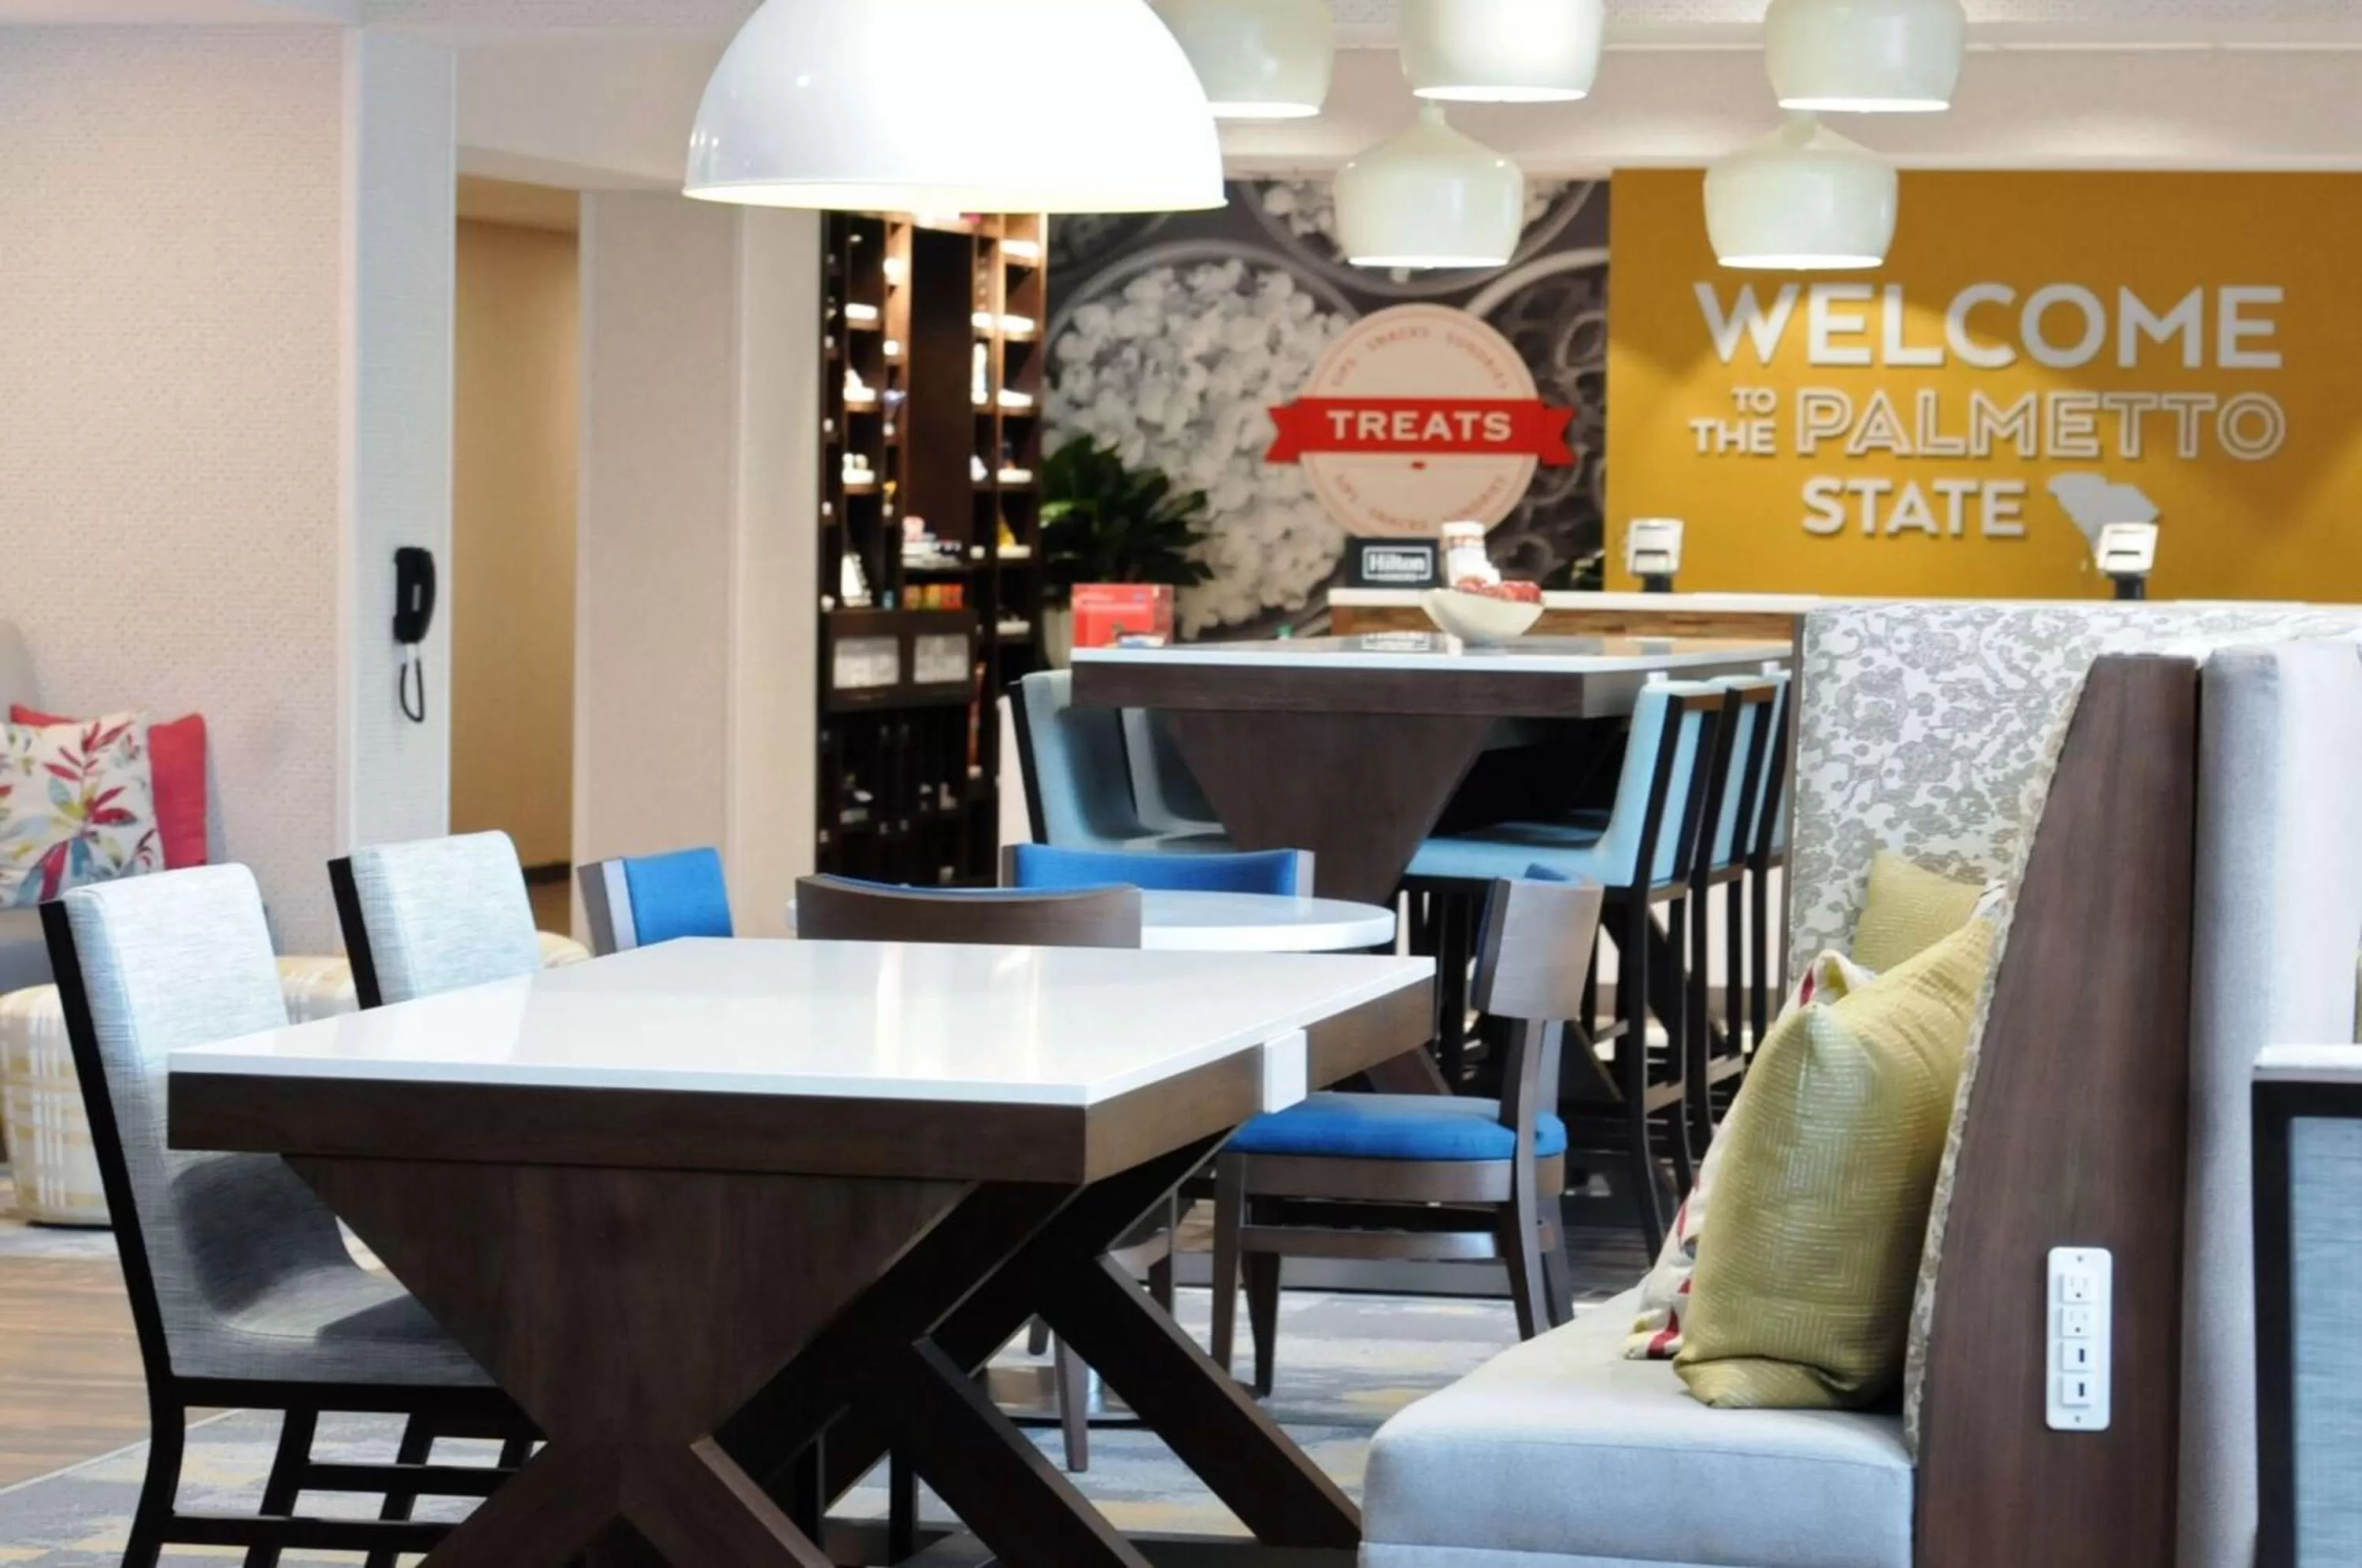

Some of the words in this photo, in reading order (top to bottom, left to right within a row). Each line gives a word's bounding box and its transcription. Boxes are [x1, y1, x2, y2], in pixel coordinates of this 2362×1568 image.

[1694, 283, 2283, 368] WELCOME
[1731, 386, 1777, 414] TO
[1327, 410, 1512, 441] TREATS
[1690, 419, 1776, 454] THE
[1795, 387, 2286, 460] PALMETTO
[1801, 477, 2027, 536] STATE
[1368, 553, 1426, 571] Hilton
